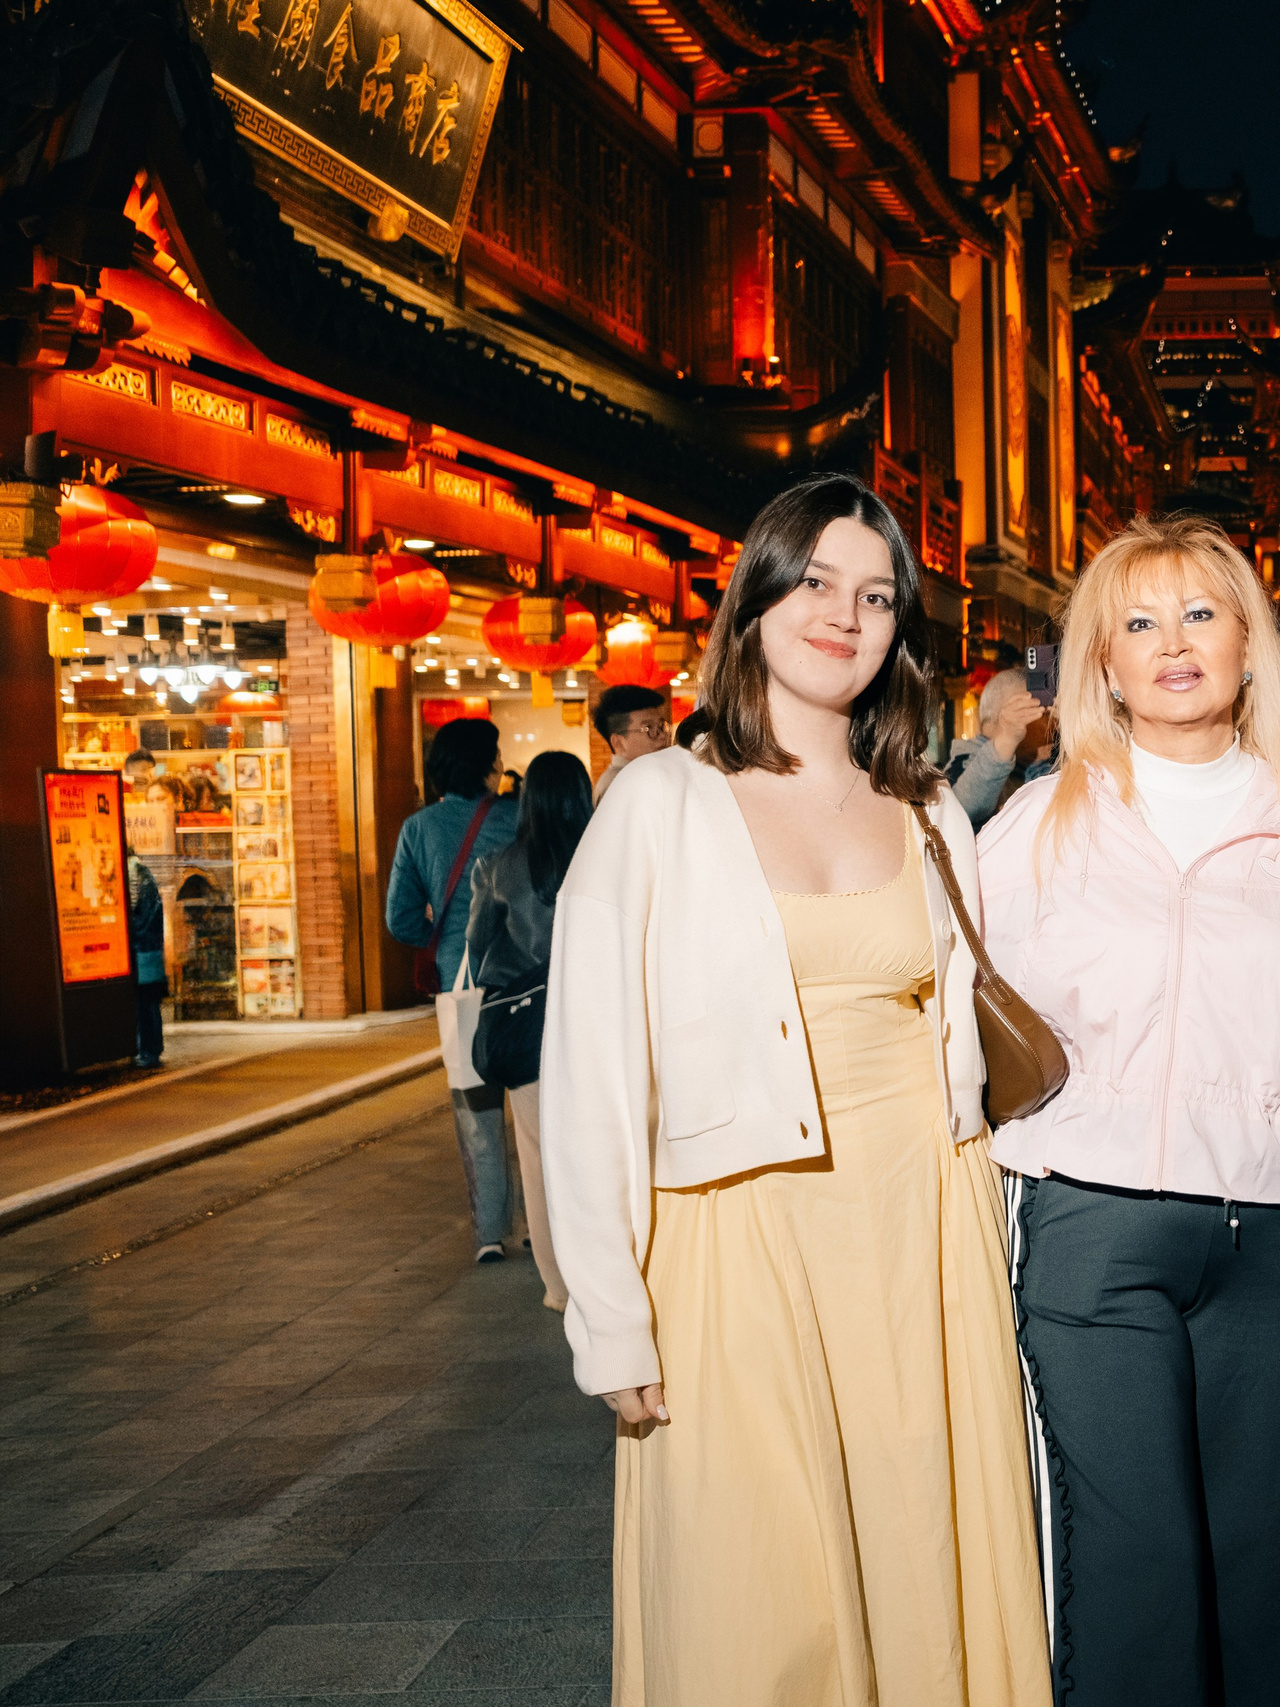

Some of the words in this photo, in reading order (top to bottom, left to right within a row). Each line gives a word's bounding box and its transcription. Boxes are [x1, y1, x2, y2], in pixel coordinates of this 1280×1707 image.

[208, 0, 460, 165] 廟食品商店
